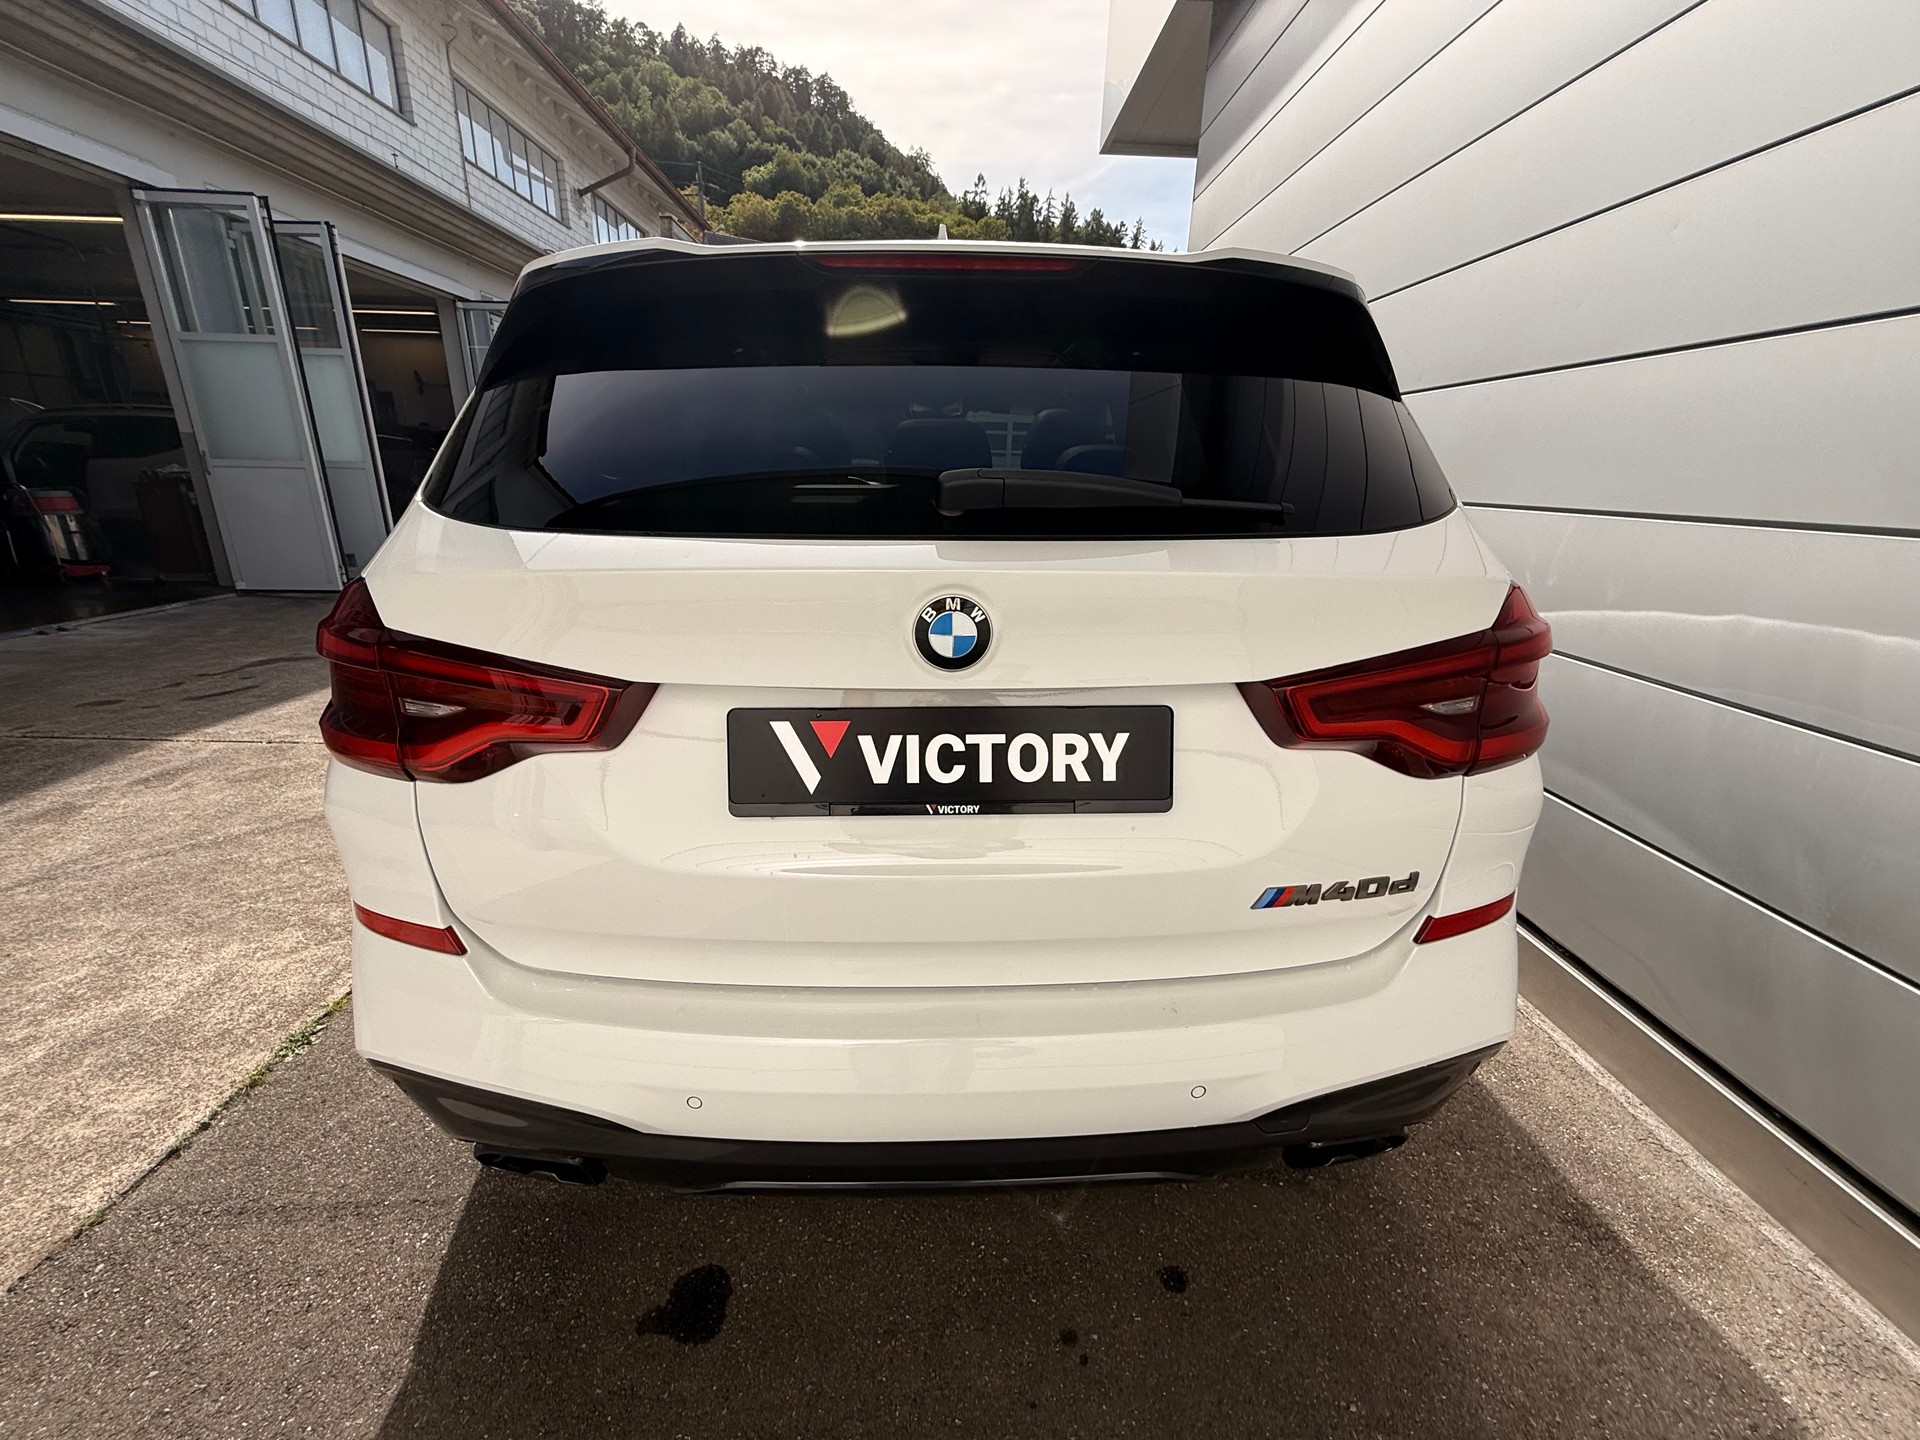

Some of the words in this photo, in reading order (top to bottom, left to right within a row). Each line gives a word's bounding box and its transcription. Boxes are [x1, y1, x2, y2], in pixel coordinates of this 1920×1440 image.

[921, 597, 986, 623] BMW
[857, 732, 1130, 784] VICTORY
[937, 804, 980, 814] VICTORY
[1282, 871, 1420, 906] M40d
